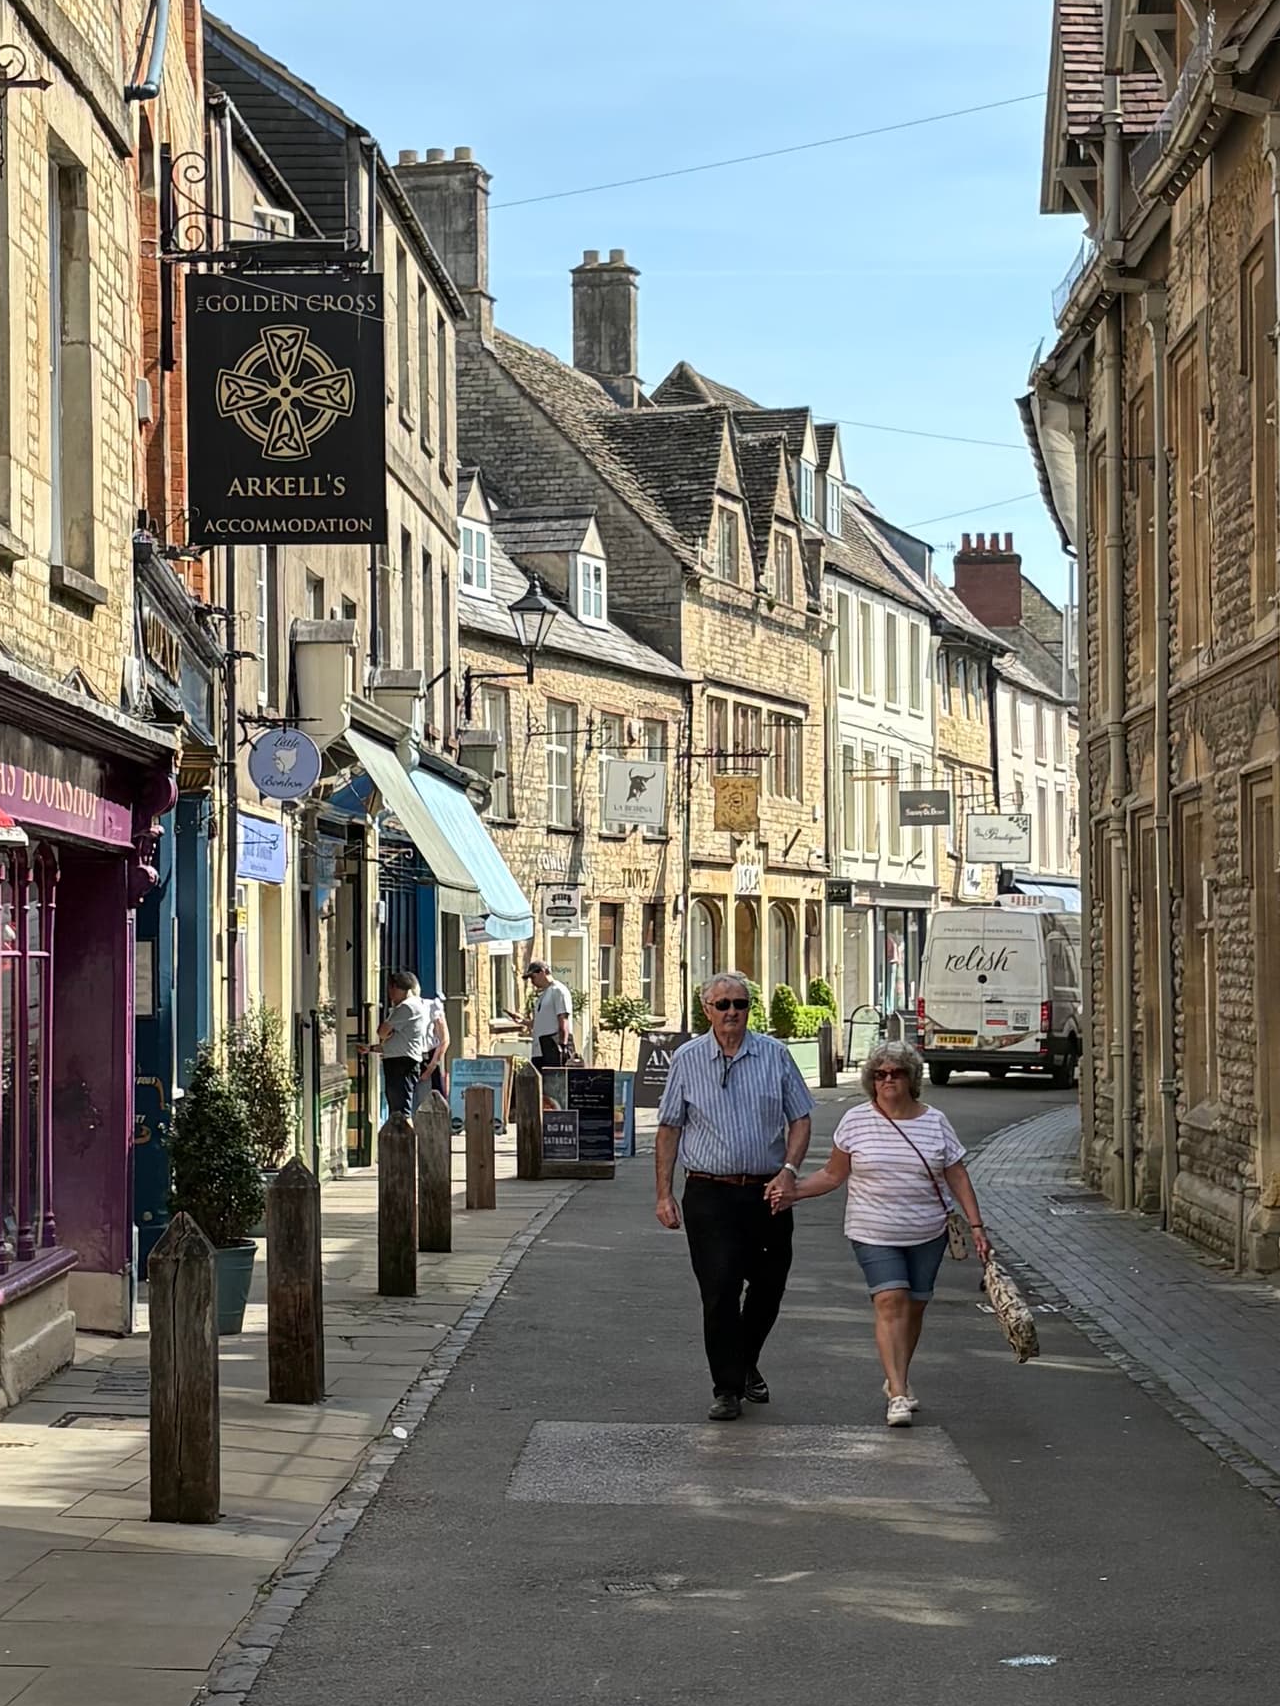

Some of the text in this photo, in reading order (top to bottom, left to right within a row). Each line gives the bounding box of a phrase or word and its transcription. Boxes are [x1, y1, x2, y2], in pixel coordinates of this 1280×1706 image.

[205, 293, 377, 314] GOLDEN CROSS
[226, 474, 346, 497] ARKELL'S
[203, 517, 373, 534] ACCOMMODATION
[944, 944, 1018, 974] relish
